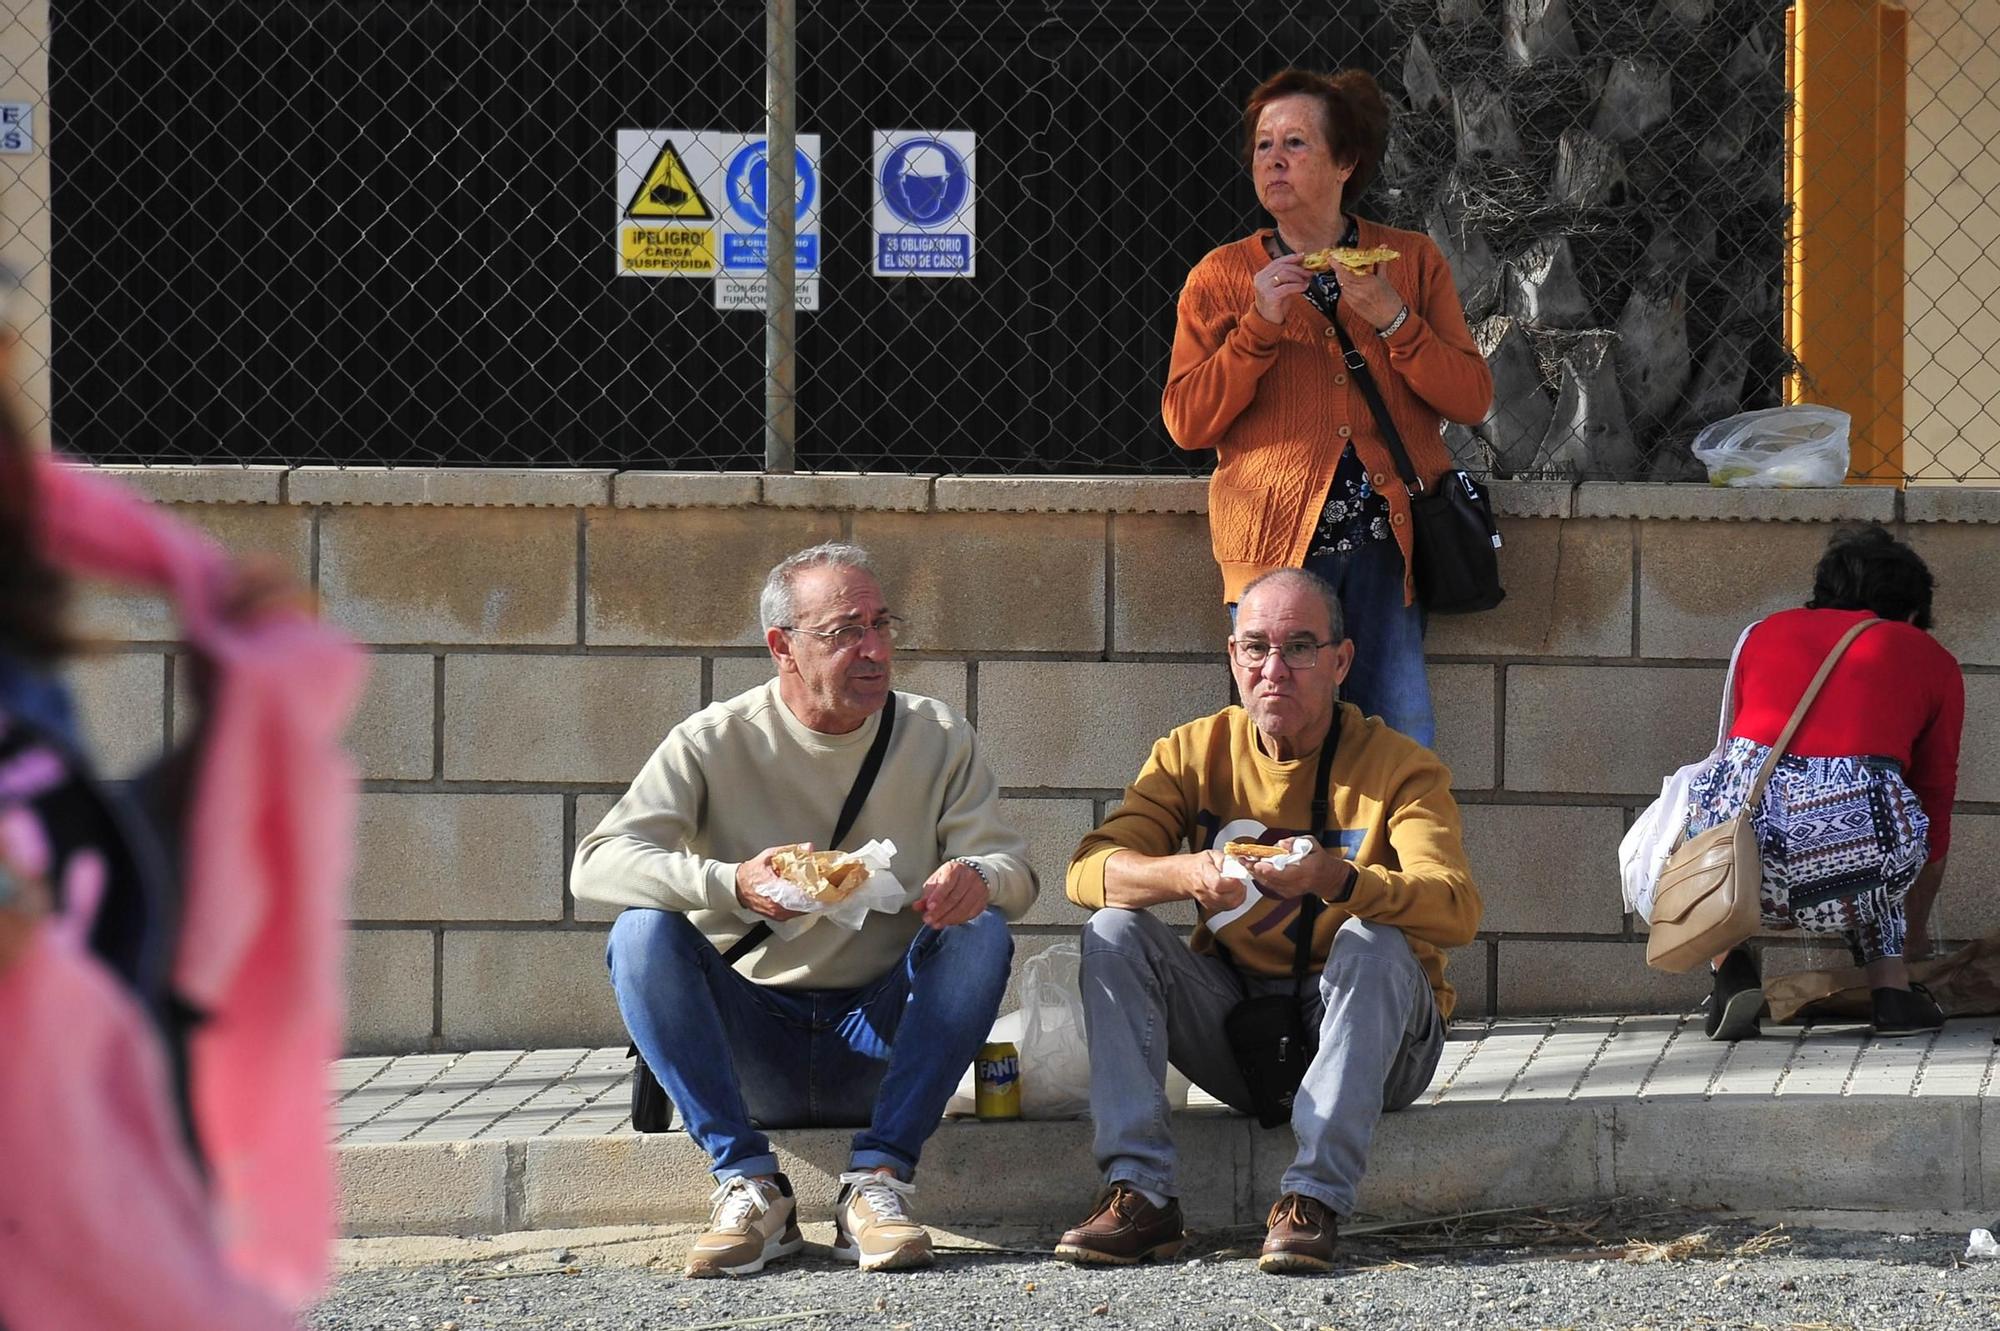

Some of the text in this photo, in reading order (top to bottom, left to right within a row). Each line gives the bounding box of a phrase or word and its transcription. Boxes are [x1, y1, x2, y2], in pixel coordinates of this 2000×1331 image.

[887, 238, 962, 252] ES OBLIGATORIO
[645, 247, 692, 257] CARGA
[626, 259, 712, 269] SUSPENDIDA
[884, 254, 965, 269] EL USO DE CASCO
[726, 284, 748, 294] CON
[980, 1056, 1019, 1079] FANT
